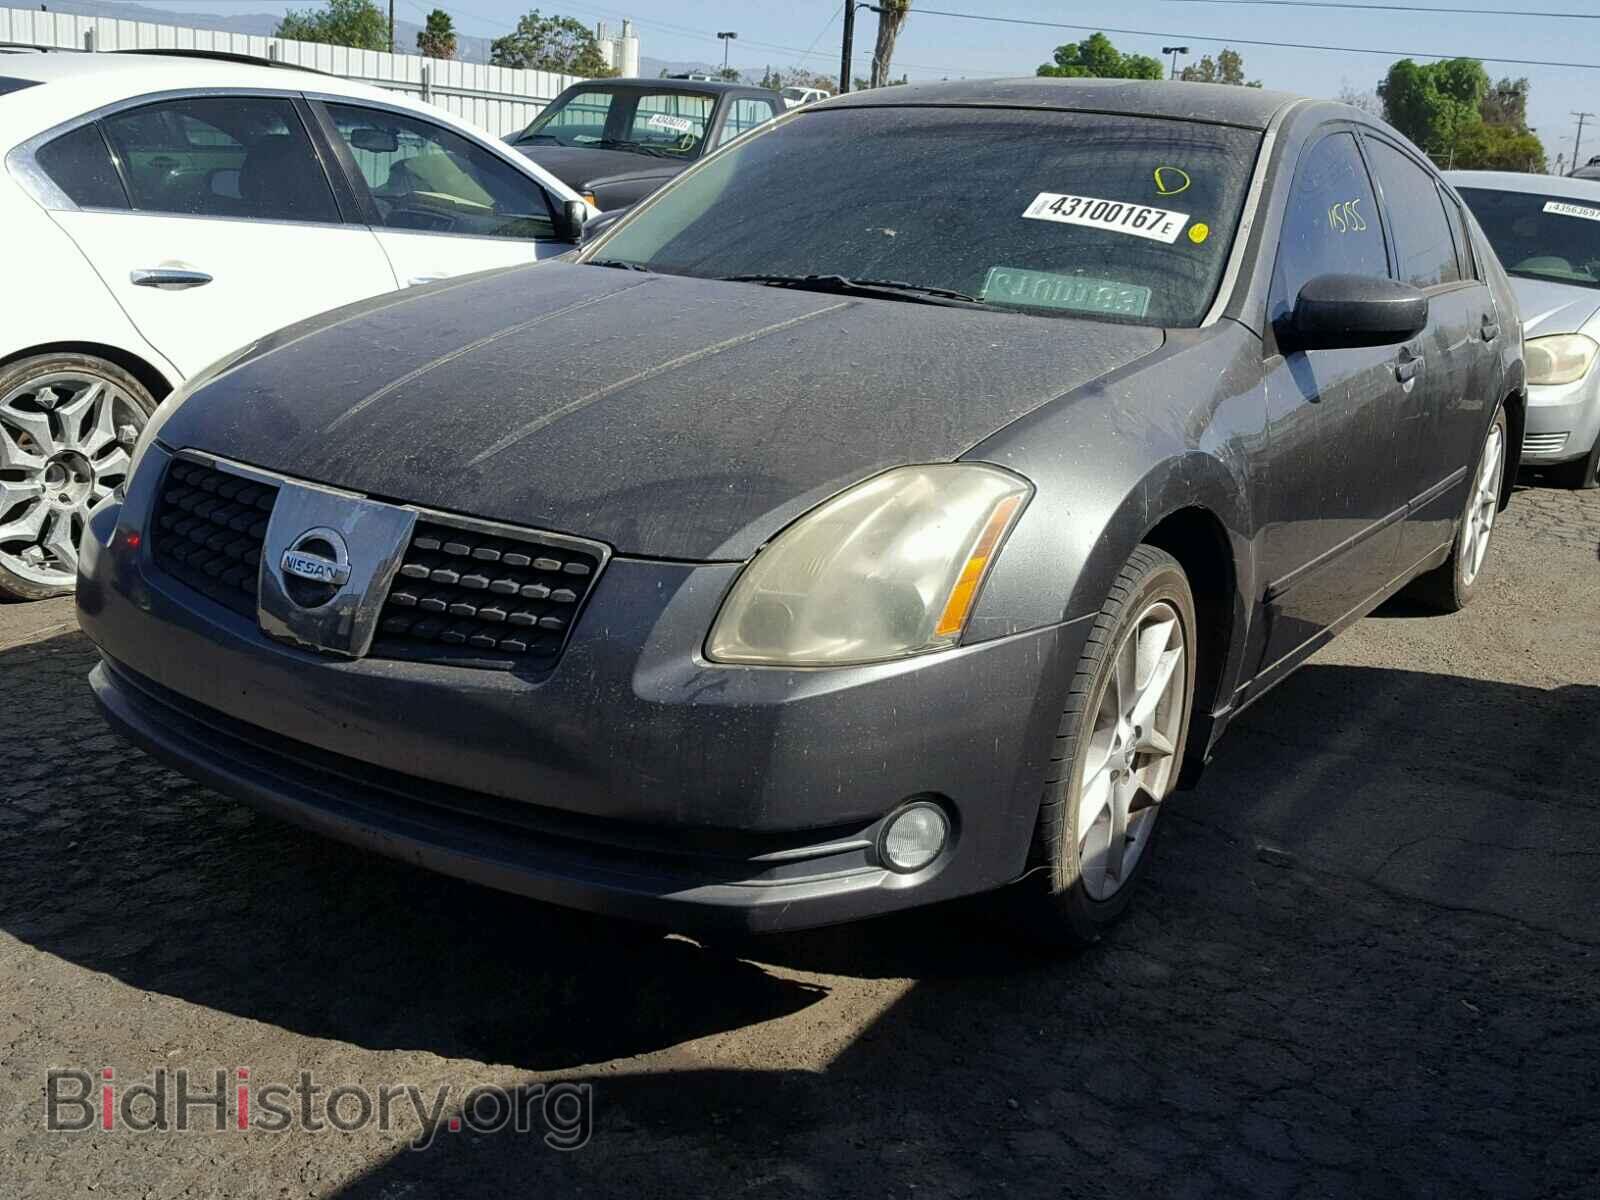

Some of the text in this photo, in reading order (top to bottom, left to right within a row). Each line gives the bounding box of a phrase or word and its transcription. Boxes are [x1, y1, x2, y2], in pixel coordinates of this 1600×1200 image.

[1153, 166, 1191, 196] D
[1048, 196, 1168, 231] 43100167
[1163, 222, 1174, 234] E
[284, 554, 338, 579] NISSAN
